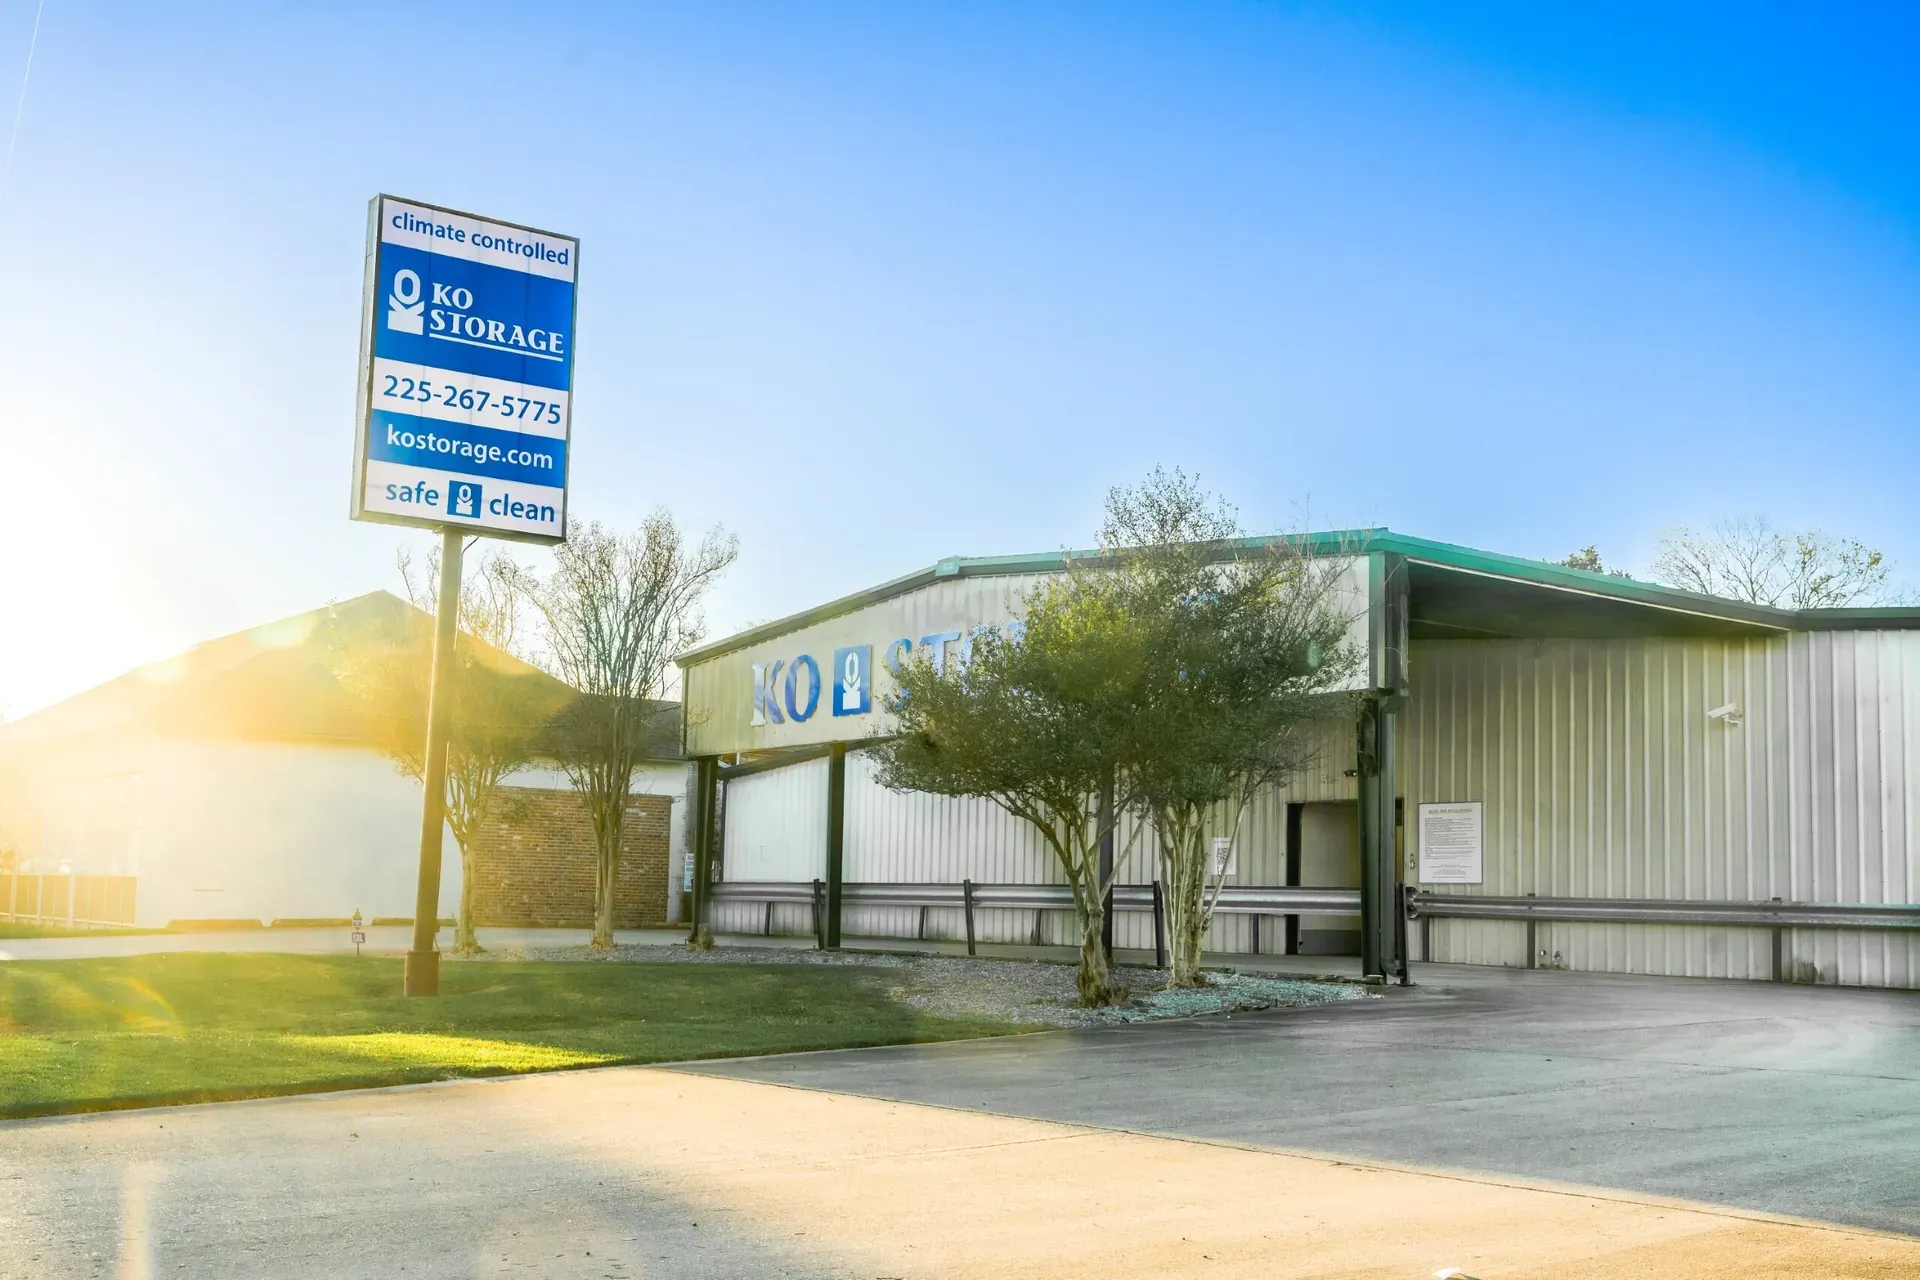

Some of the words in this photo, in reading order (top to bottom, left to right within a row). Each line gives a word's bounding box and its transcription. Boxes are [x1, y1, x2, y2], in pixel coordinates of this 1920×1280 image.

[392, 213, 466, 243] climate
[471, 232, 569, 266] controlled
[432, 282, 473, 310] KO
[429, 309, 564, 354] STORAGE
[383, 374, 561, 425] 225-267-5775
[387, 424, 553, 469] kostorage.com
[385, 480, 439, 506] safe
[489, 494, 556, 523] clean
[750, 654, 821, 727] KO
